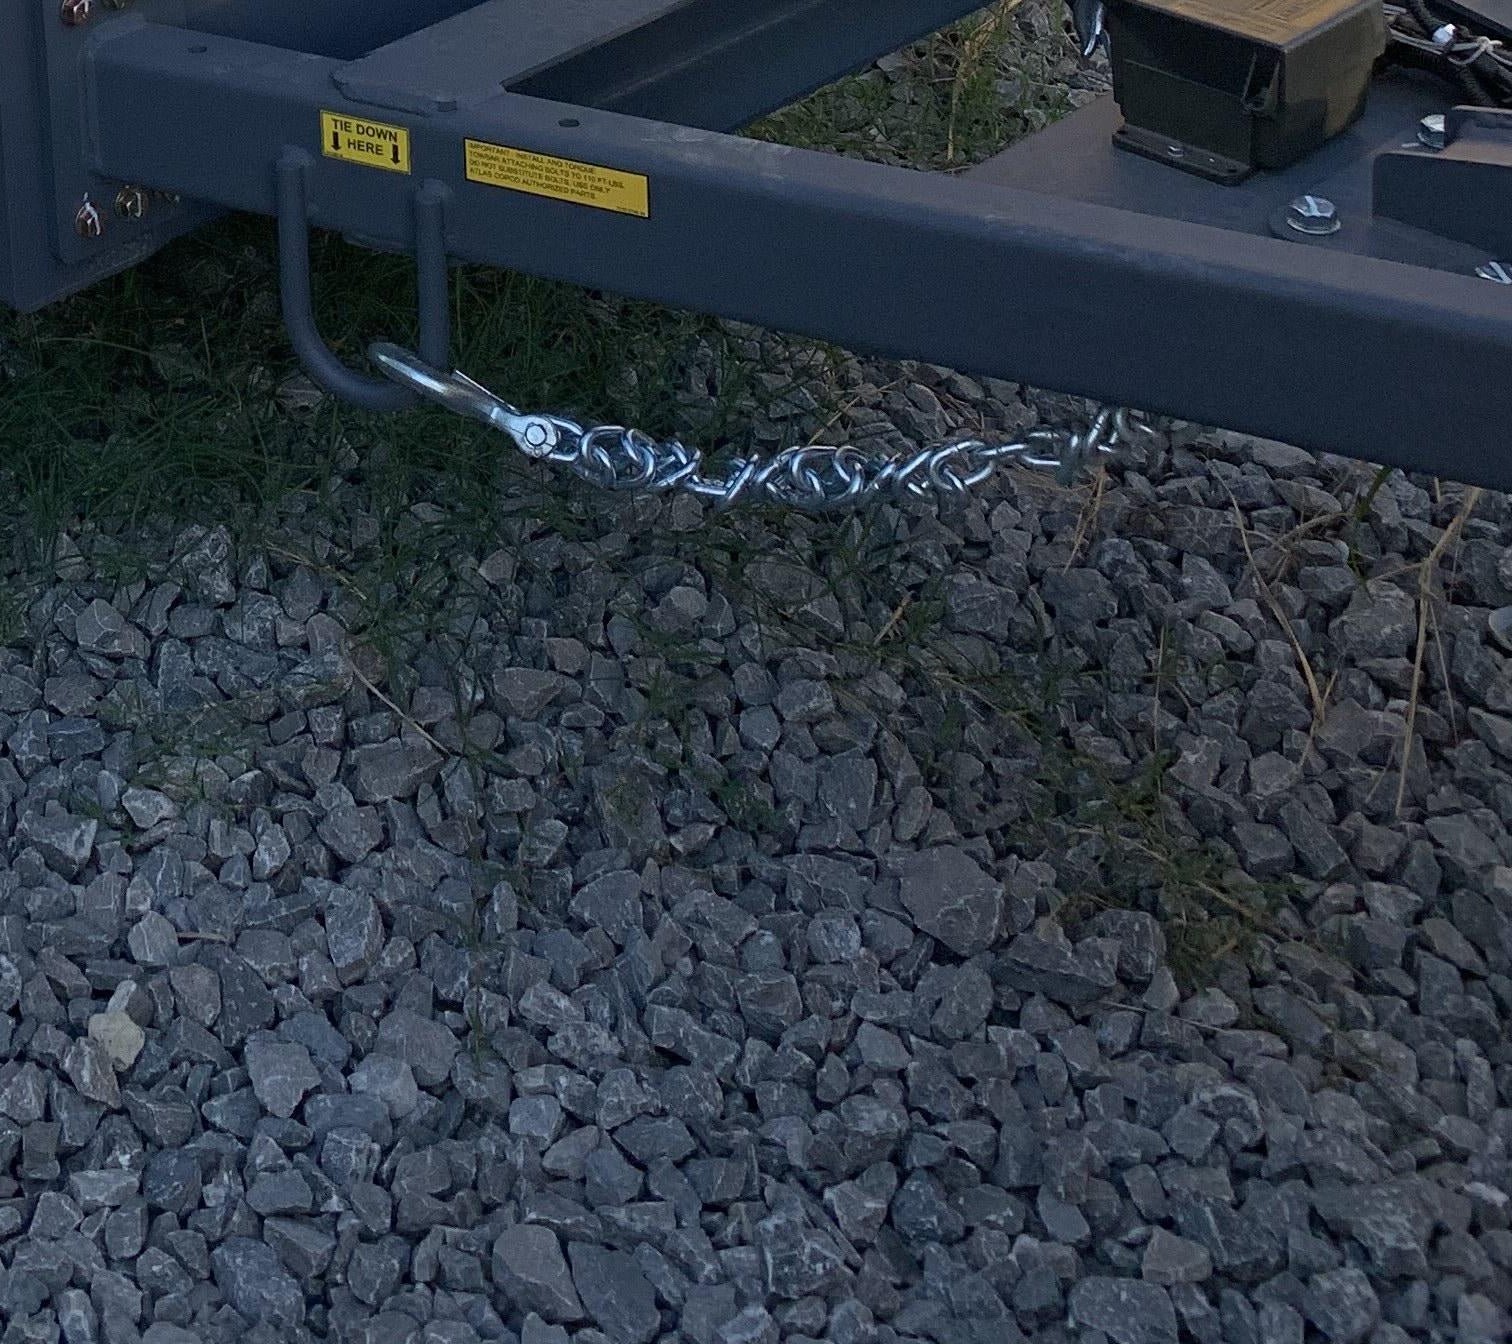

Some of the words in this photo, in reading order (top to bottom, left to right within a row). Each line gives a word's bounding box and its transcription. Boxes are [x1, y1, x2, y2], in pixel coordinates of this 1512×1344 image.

[331, 118, 353, 133] TIE
[355, 123, 398, 143] DOWN
[347, 138, 384, 156] HERE
[546, 158, 563, 168] AND
